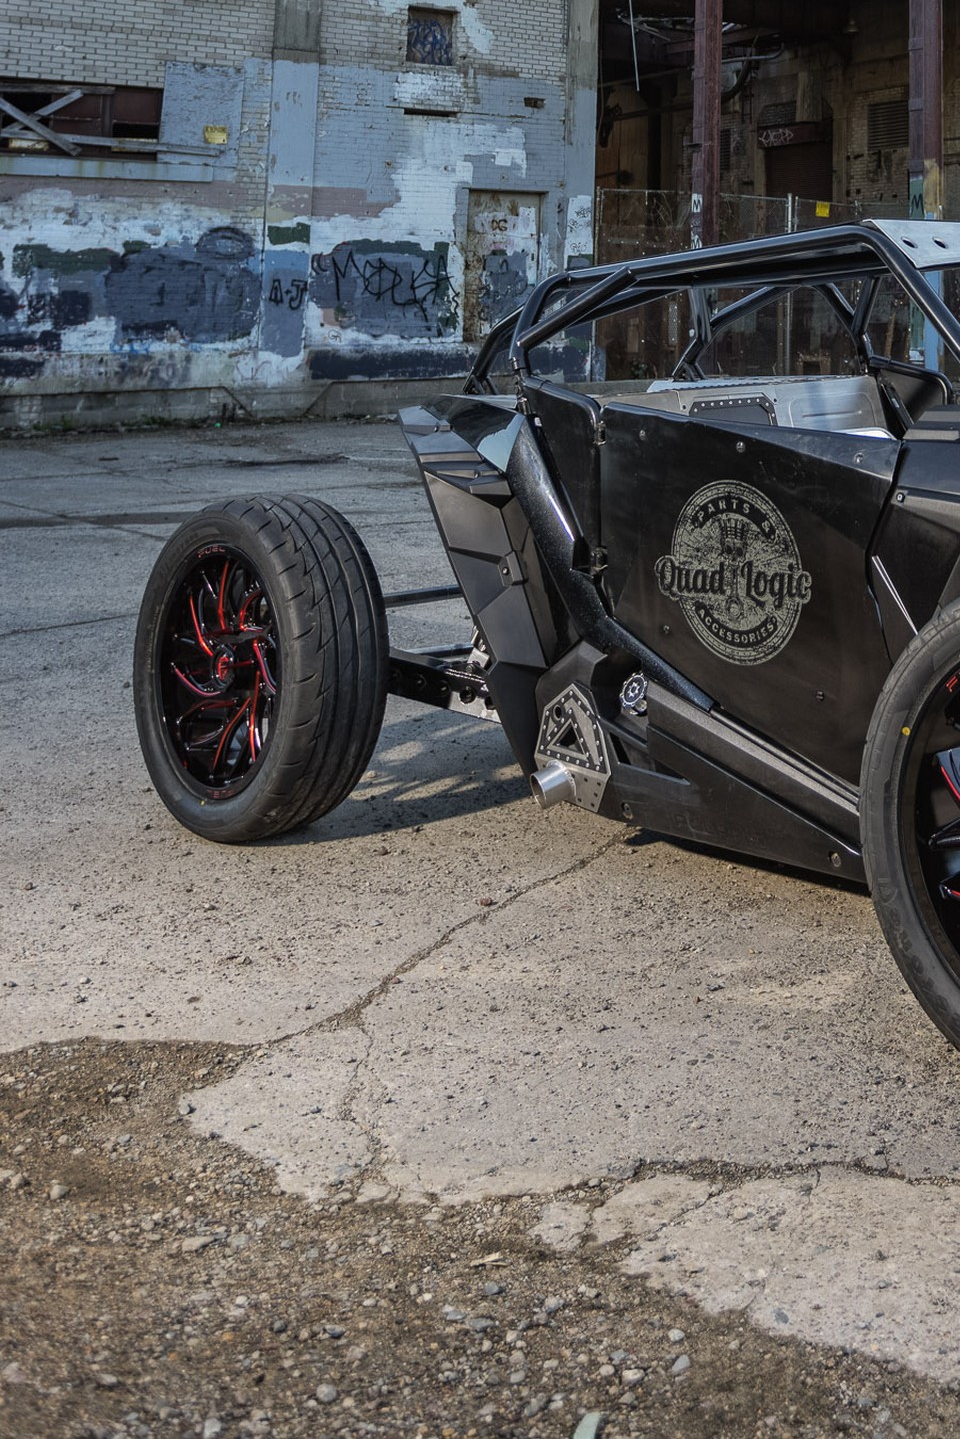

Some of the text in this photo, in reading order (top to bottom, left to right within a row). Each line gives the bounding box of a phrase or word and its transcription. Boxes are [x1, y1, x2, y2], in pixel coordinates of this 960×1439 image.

[698, 499, 751, 523] PARTS
[658, 558, 811, 610] Quad Logic
[699, 609, 775, 644] ACCESSORIES
